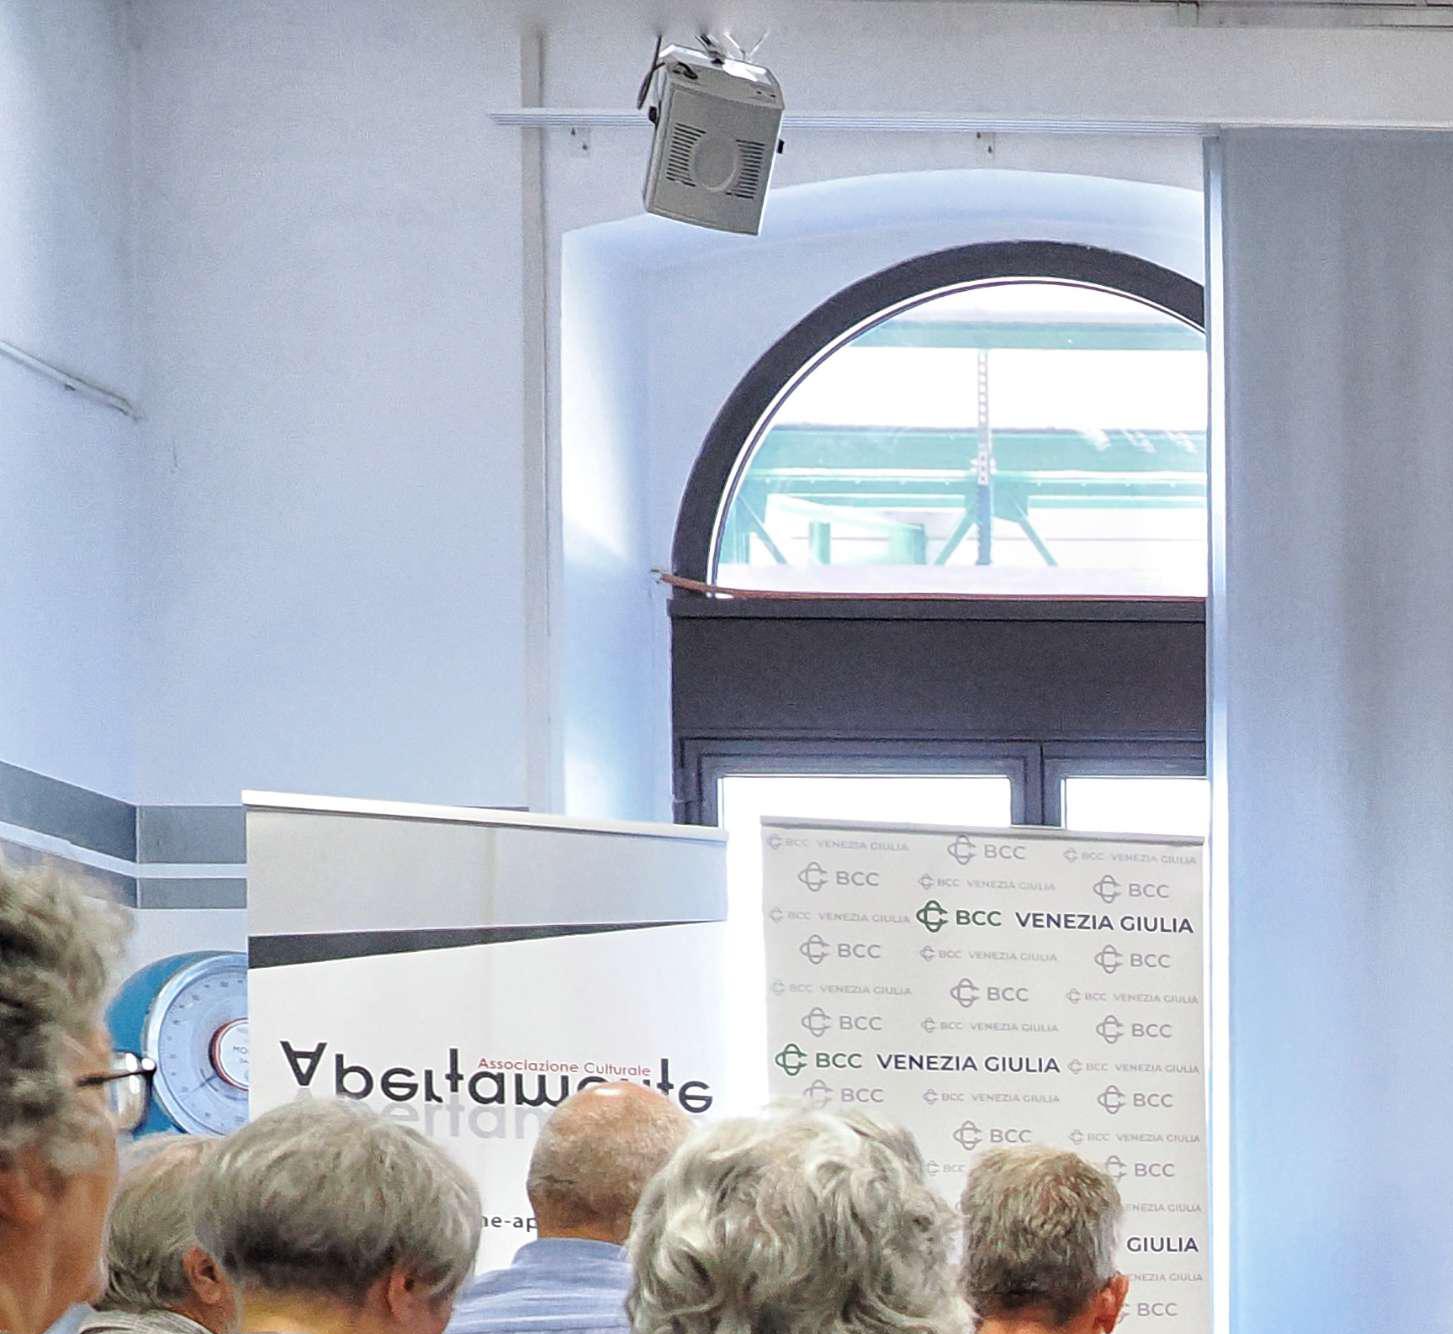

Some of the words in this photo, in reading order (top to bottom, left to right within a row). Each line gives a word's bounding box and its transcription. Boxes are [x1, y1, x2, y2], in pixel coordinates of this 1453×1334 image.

[984, 844, 1025, 859] BCC
[836, 871, 879, 886] BCC
[1128, 884, 1170, 898] BCC
[956, 910, 1002, 926] BCC
[1015, 912, 1115, 930] VENEZIA
[1120, 916, 1194, 933] GIULIA
[838, 944, 881, 958] BCC
[1130, 953, 1171, 968] BCC
[987, 987, 1029, 1002] BCC
[840, 1016, 882, 1030] BCC
[1132, 1023, 1172, 1038] BCC
[478, 1057, 578, 1074] Associazione
[584, 1060, 651, 1076] Culturale
[816, 1053, 863, 1068] BCC
[876, 1054, 978, 1071] VENEZIA
[985, 1056, 1060, 1073] GIULIA
[841, 1088, 884, 1103] BCC
[1133, 1093, 1173, 1108] BCC
[989, 1129, 1032, 1143] BCC
[1134, 1163, 1174, 1177] BCC
[1126, 1237, 1199, 1253] GIULIA
[1137, 1303, 1177, 1316] BCC
